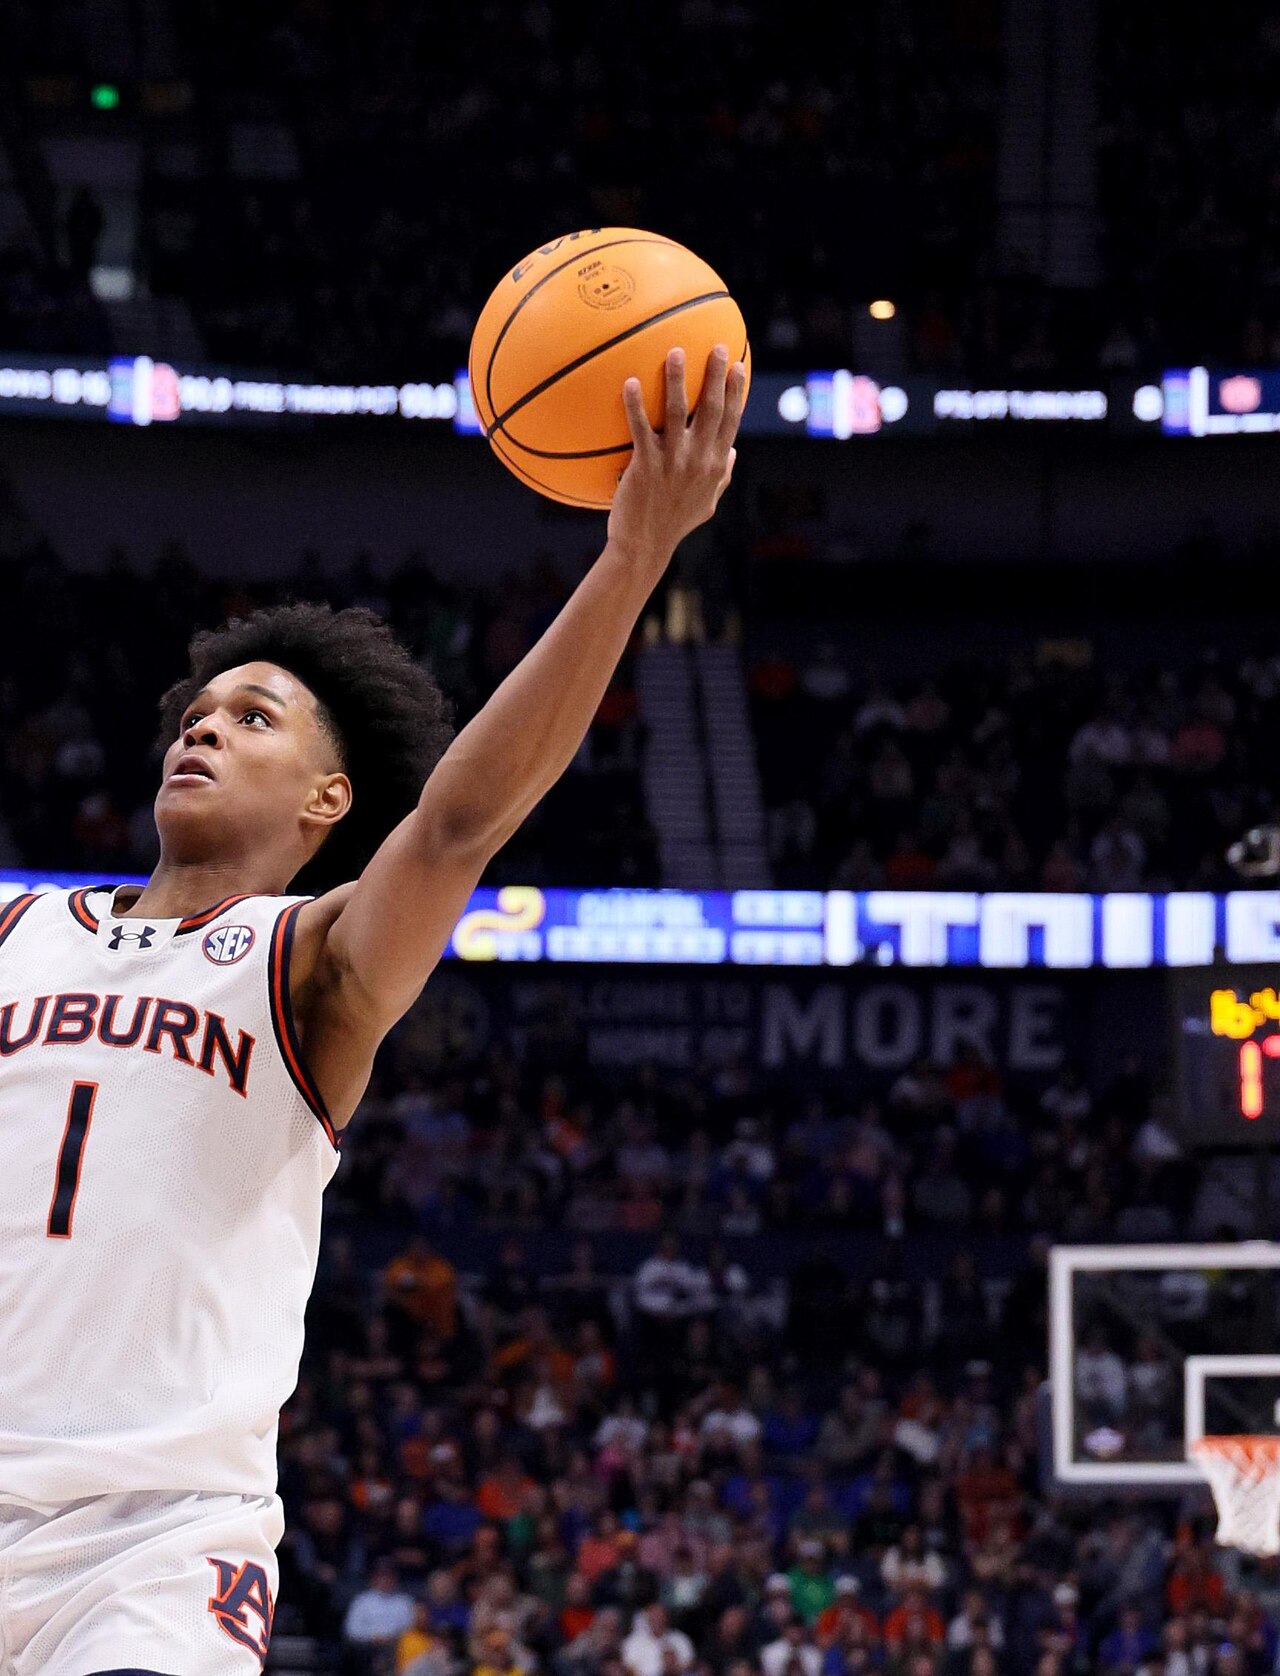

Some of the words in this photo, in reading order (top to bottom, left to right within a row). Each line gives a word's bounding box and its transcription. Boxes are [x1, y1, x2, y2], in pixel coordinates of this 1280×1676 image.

[206, 926, 253, 961] SEC
[762, 982, 1067, 1069] MORE
[46, 1080, 100, 1239] 1
